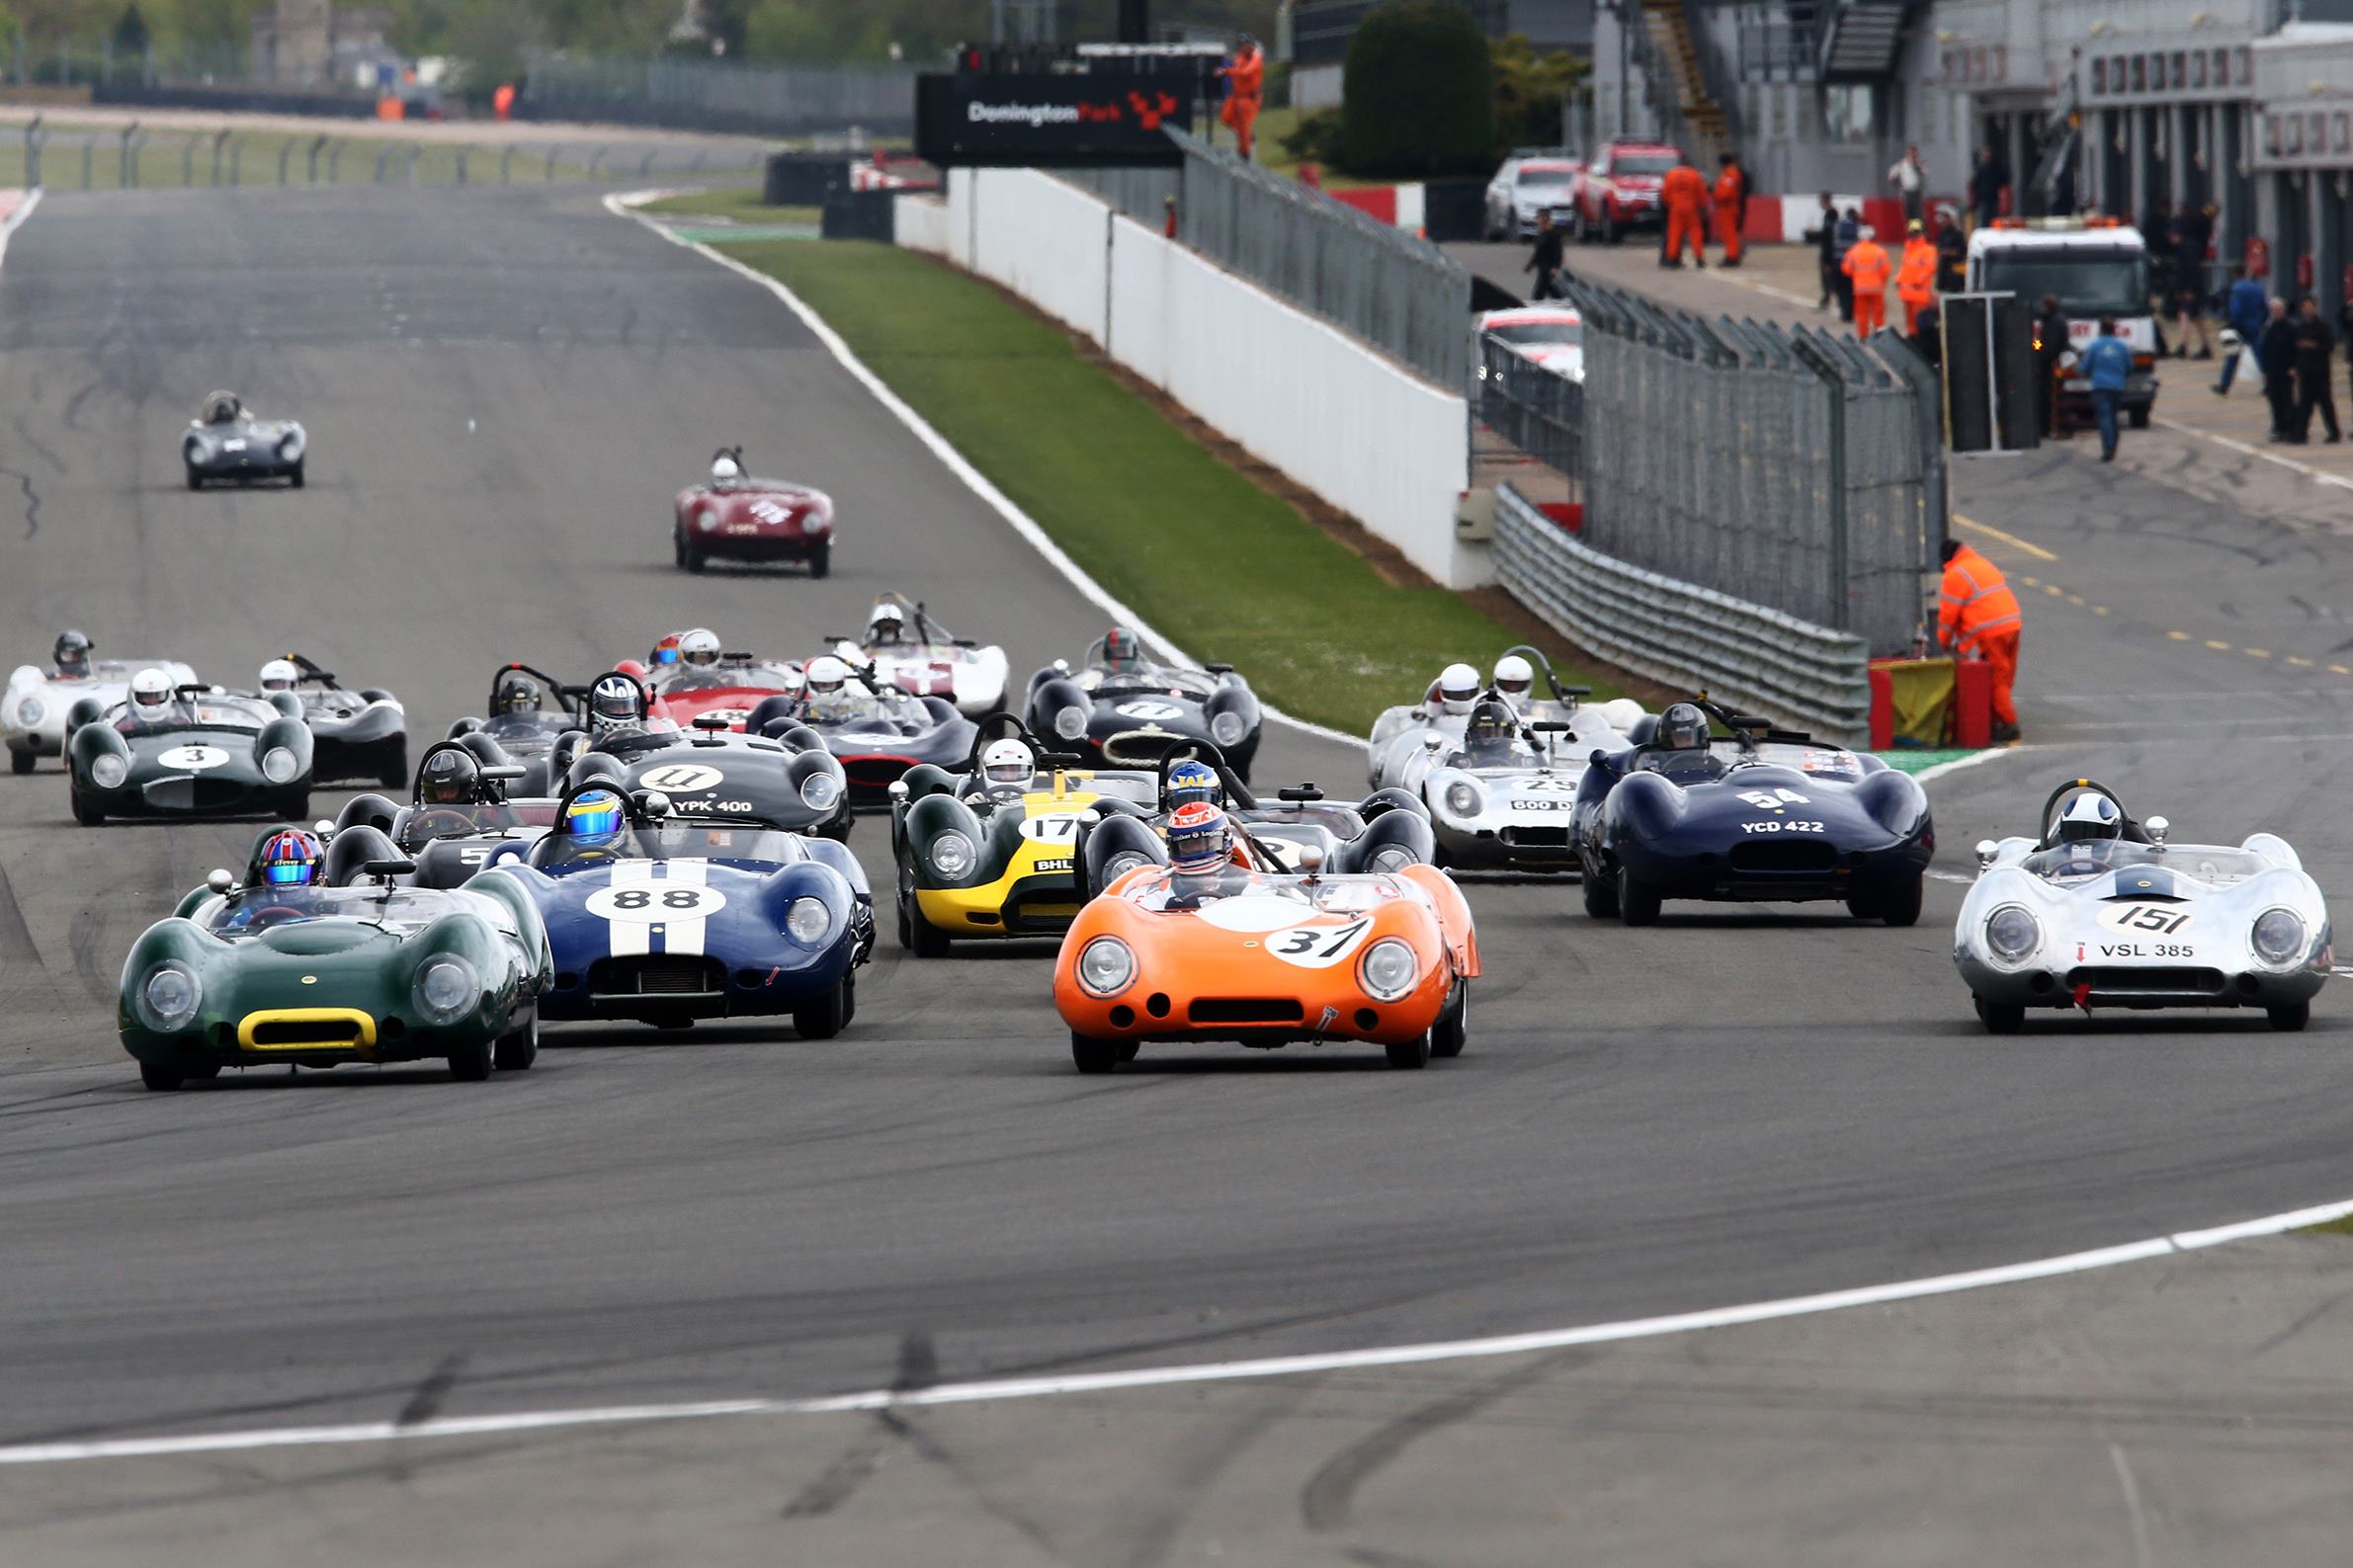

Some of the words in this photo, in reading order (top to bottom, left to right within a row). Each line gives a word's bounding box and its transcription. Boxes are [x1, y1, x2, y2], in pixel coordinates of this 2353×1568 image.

[184, 749, 205, 762] 3
[1735, 787, 1811, 808] 54
[674, 800, 714, 811] YPK
[1513, 800, 1552, 811] 600
[1036, 819, 1075, 838] 17
[1740, 821, 1781, 834] YCD
[1784, 821, 1824, 833] 422
[1037, 860, 1073, 870] BHL
[613, 890, 701, 909] 88
[2116, 906, 2191, 935] 151
[2100, 944, 2146, 956] VSL
[2154, 945, 2194, 957] 385
